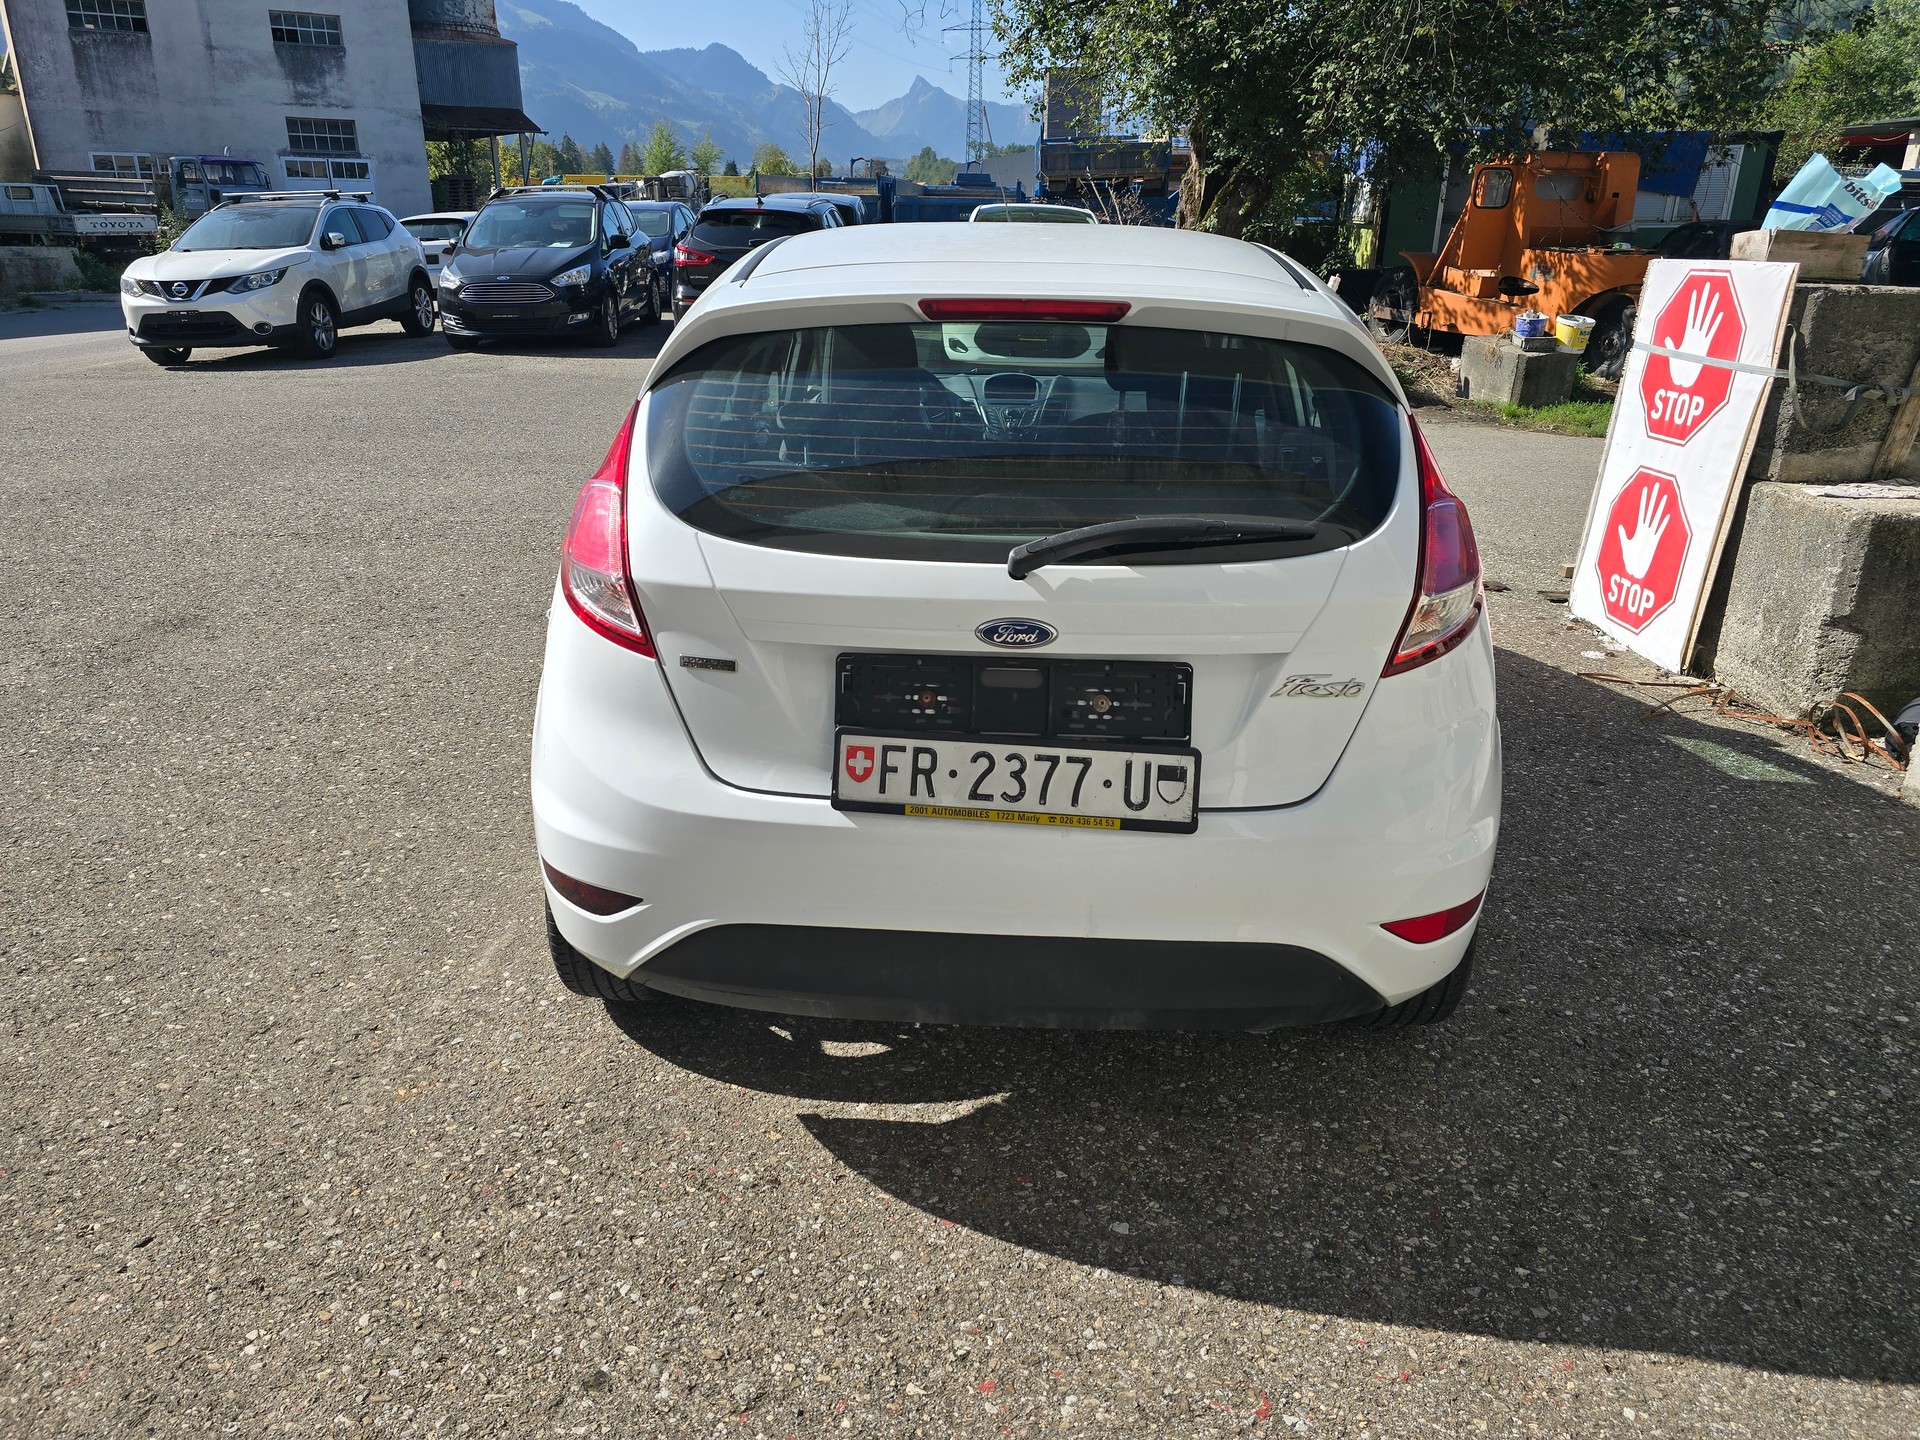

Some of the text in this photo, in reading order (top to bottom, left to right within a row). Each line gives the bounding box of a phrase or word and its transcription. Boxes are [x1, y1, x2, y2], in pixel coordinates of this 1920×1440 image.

[1650, 388, 1704, 426] STOP
[1607, 573, 1655, 616] STOP
[993, 625, 1039, 642] Ford
[1269, 674, 1366, 698] Fiesta
[910, 806, 1115, 827] 2001 AUTOMOBILES 1723 Marly 026 436 54 53
